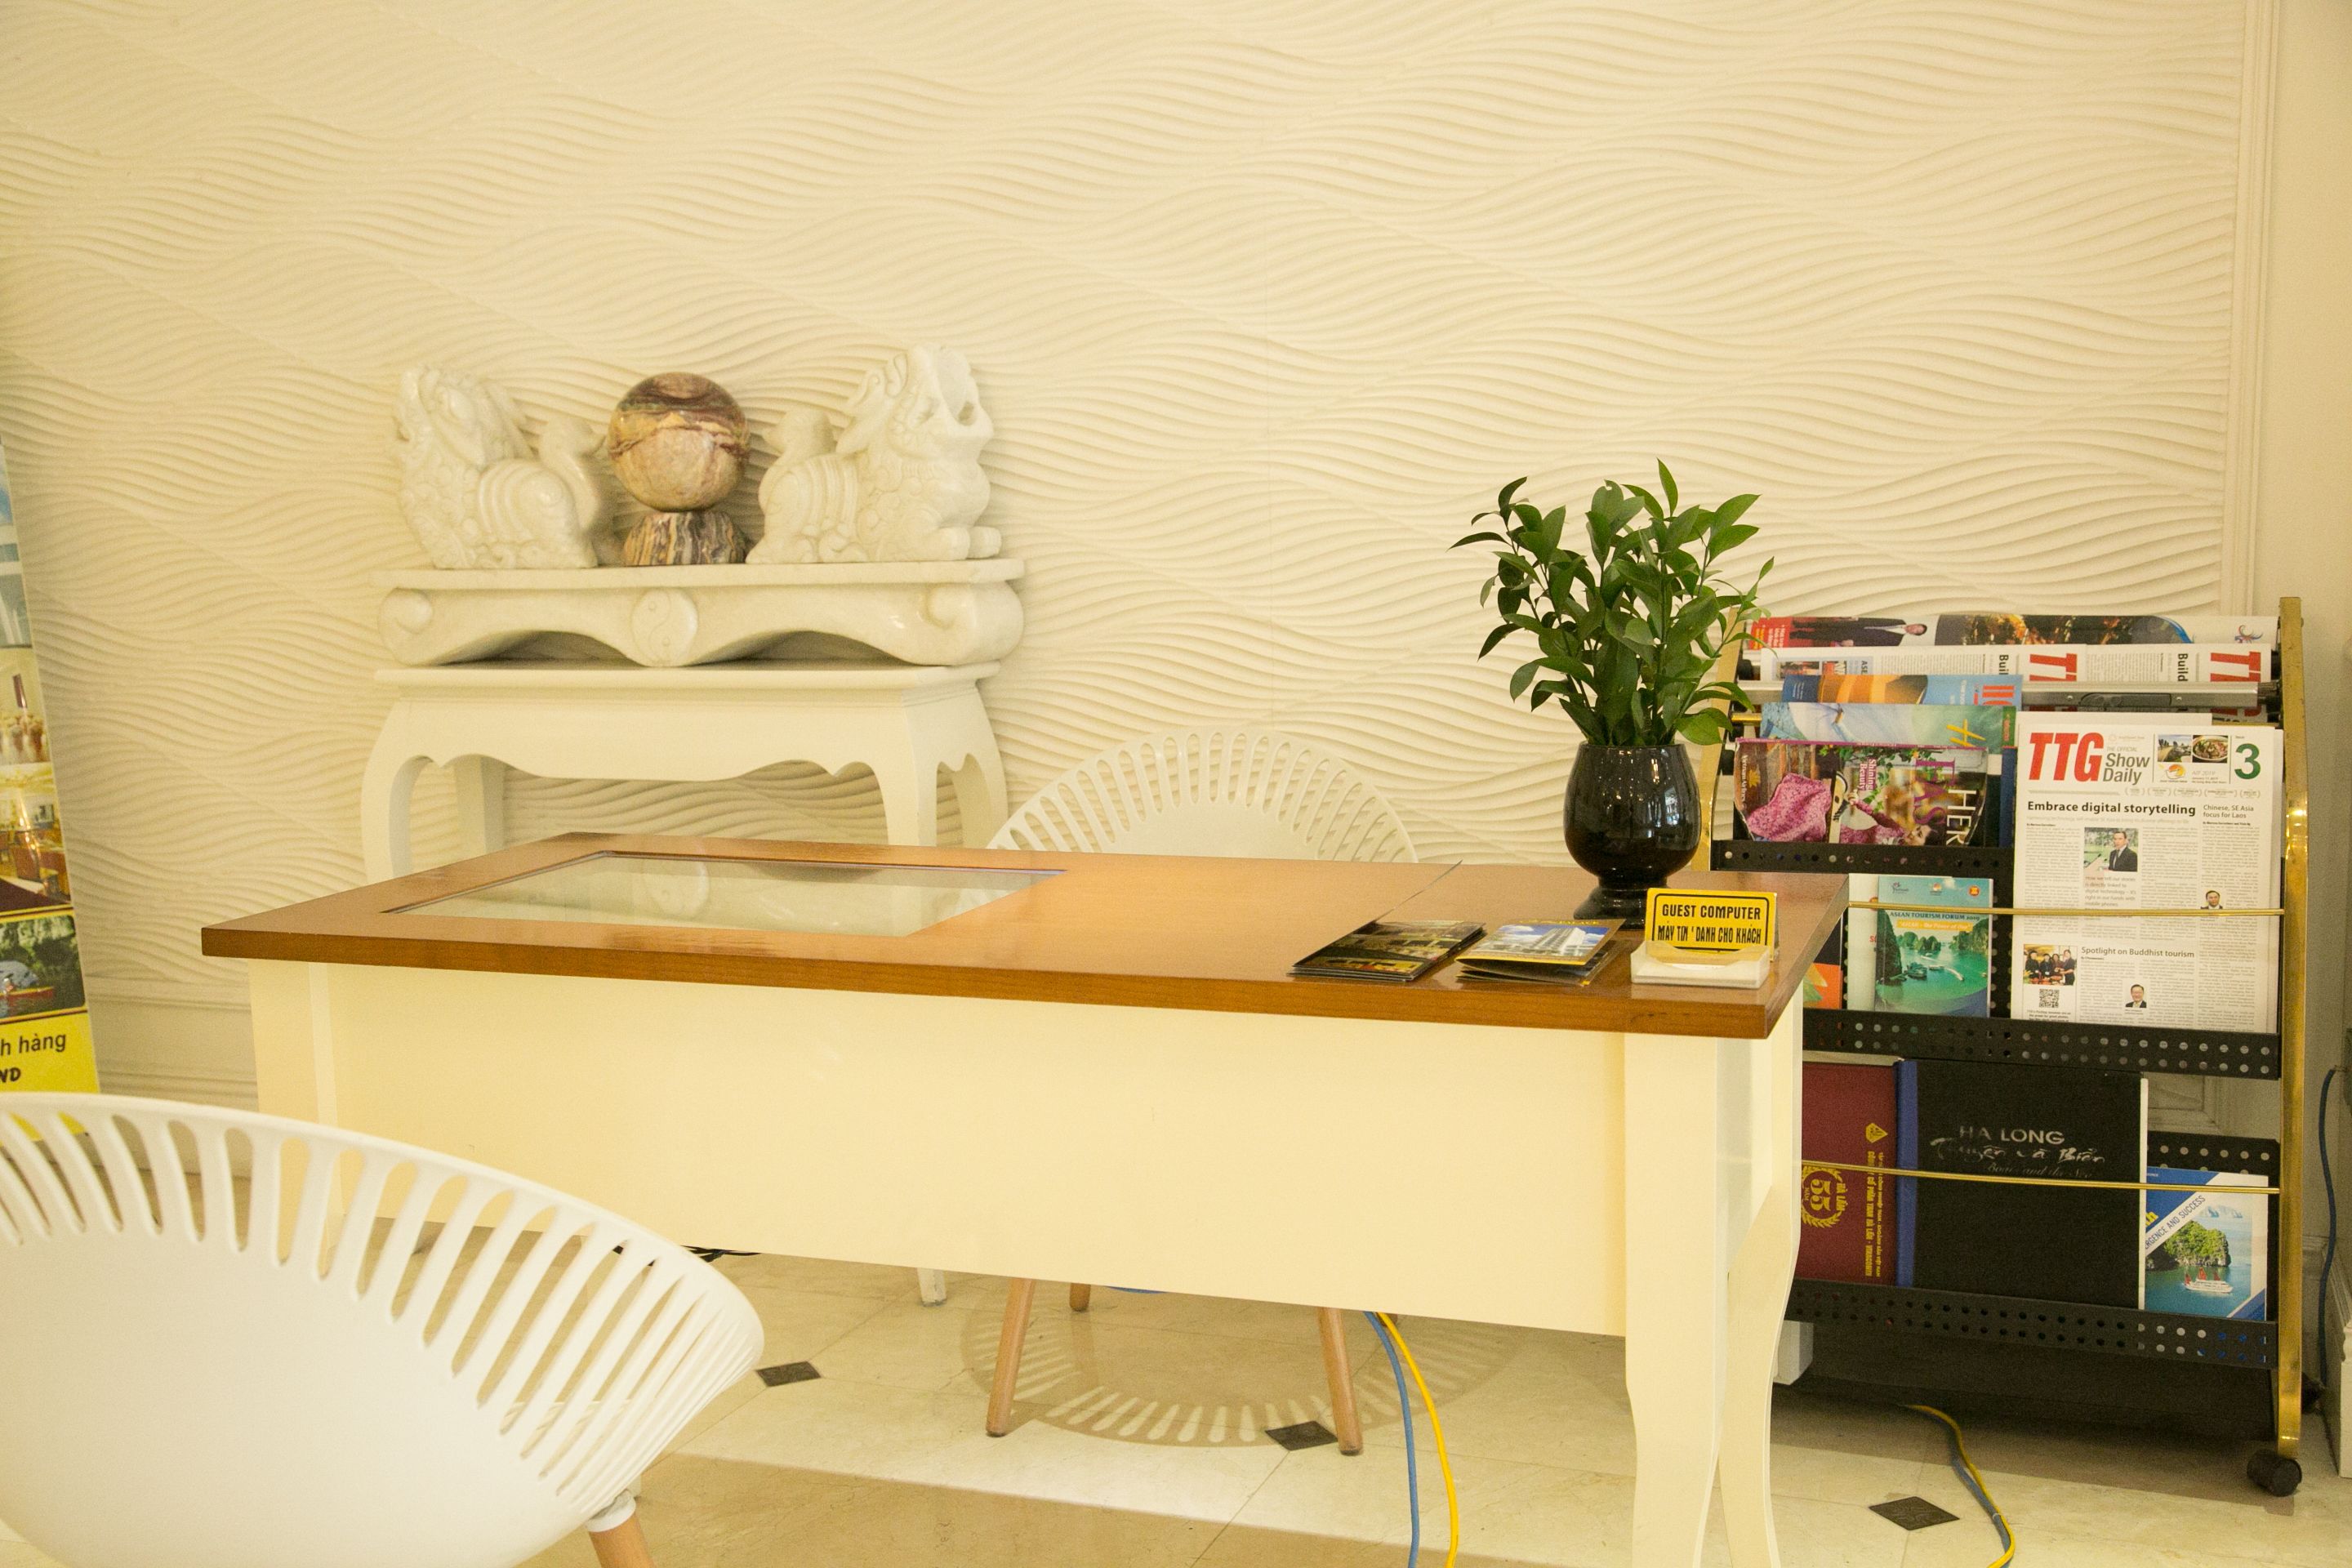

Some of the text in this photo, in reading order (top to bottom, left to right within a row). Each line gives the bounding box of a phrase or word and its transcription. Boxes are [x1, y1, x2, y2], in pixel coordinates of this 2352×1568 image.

[2029, 653, 2078, 683] TT
[2029, 732, 2105, 782] TTG
[2105, 752, 2150, 768] Show
[2234, 743, 2261, 780] 3
[1859, 763, 1868, 790] Beauty
[1865, 759, 1875, 790] Shining
[2103, 768, 2142, 786] Daily
[2028, 801, 2196, 817] Embrace digital storytelling
[1662, 904, 1761, 920] GUEST COMPUTER
[1695, 927, 1715, 942] DANH
[1718, 927, 1733, 943] CHO
[2082, 947, 2116, 956] Spotlight
[2129, 948, 2163, 956] Buddhist
[19, 1033, 66, 1053] hàng
[2001, 1128, 2065, 1145] LONG
[1811, 1178, 1832, 1211] 55
[2167, 1216, 2180, 1230] AND
[2178, 1195, 2205, 1218] SUCCESS
